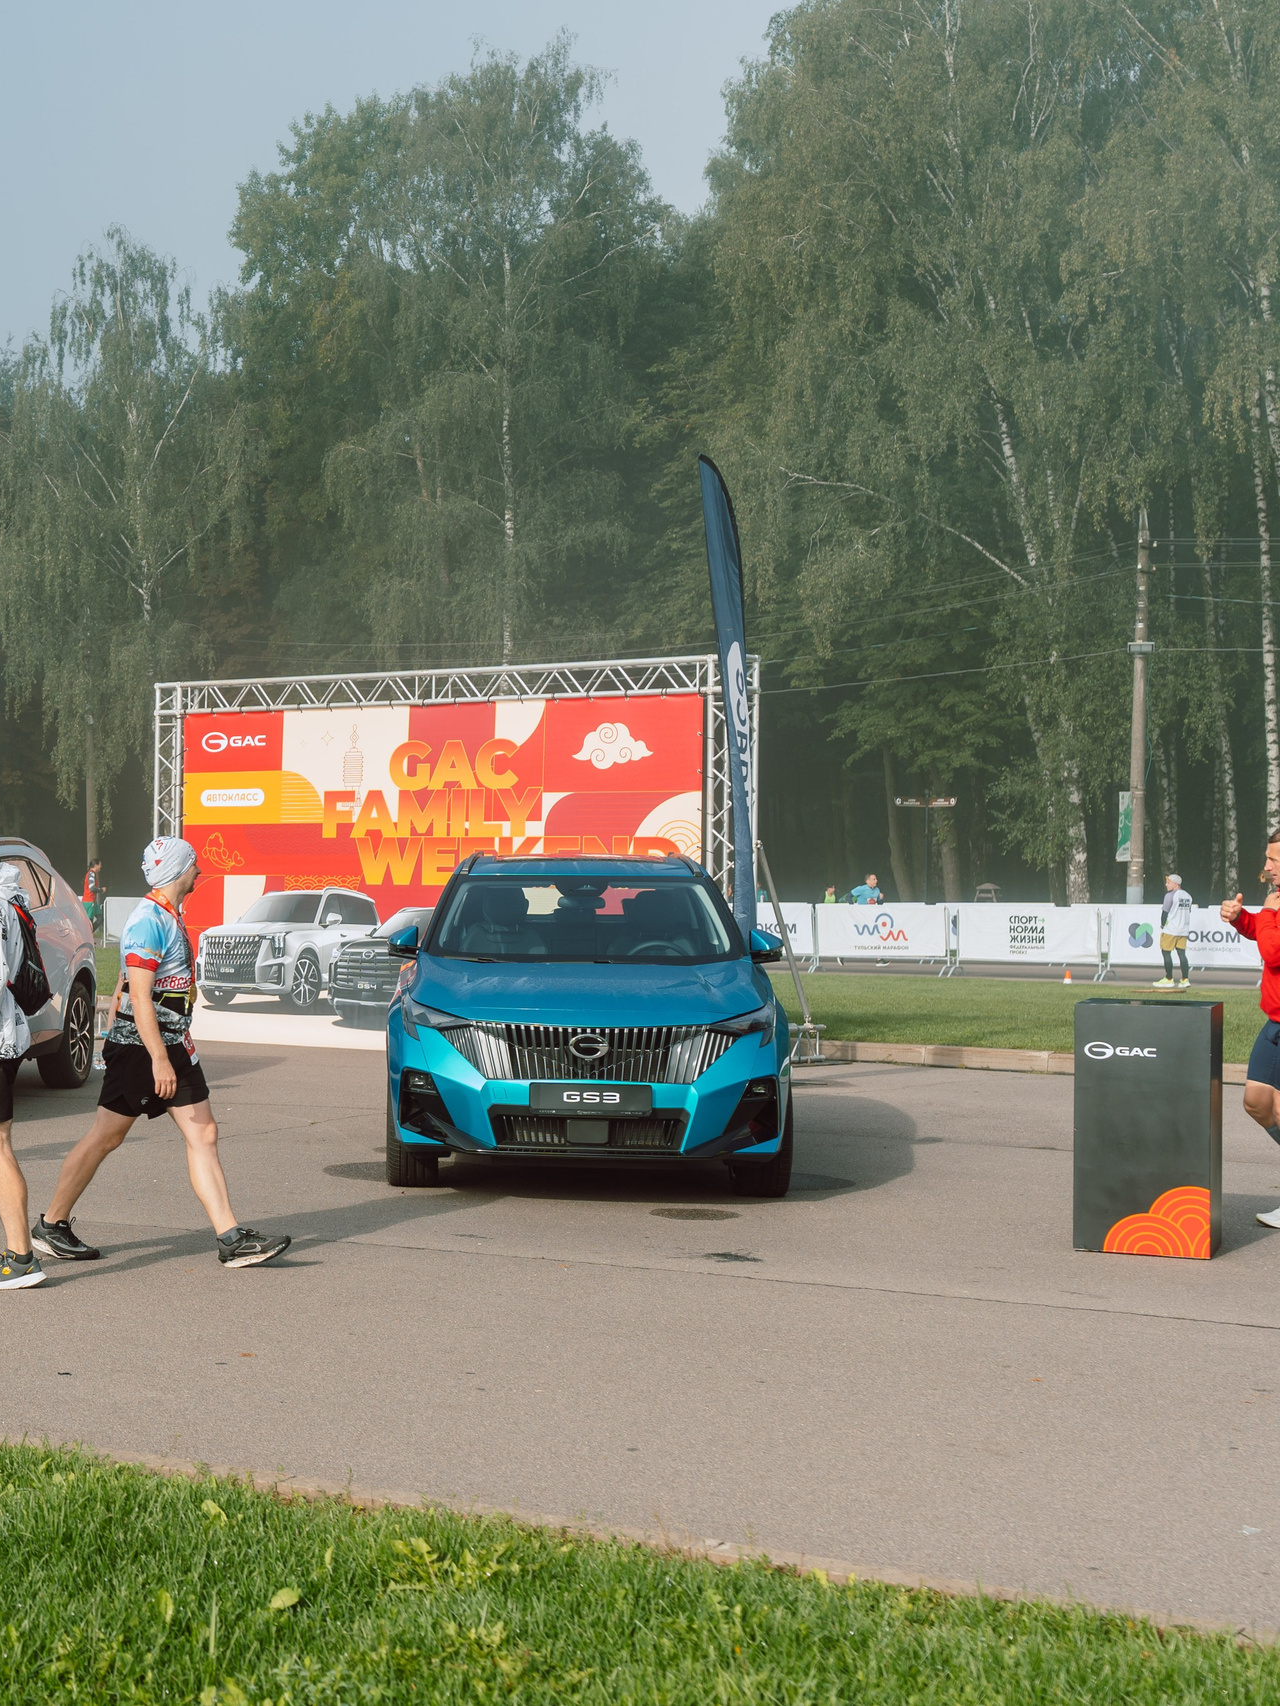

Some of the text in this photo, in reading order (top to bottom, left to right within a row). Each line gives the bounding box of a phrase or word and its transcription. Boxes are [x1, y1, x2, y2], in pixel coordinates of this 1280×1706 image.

[229, 734, 266, 747] GAC
[389, 738, 519, 790] GAC
[206, 792, 259, 802] АВТОКЛАСС
[321, 786, 543, 838] FAMILY
[1009, 915, 1039, 925] СПОРТ
[1009, 925, 1045, 934] НОРМА
[1010, 935, 1045, 944] ЖИЗНИ
[1187, 930, 1241, 944] ОКОМ
[357, 982, 377, 990] GS4
[1115, 1046, 1157, 1058] GAC
[563, 1091, 620, 1104] GS3
